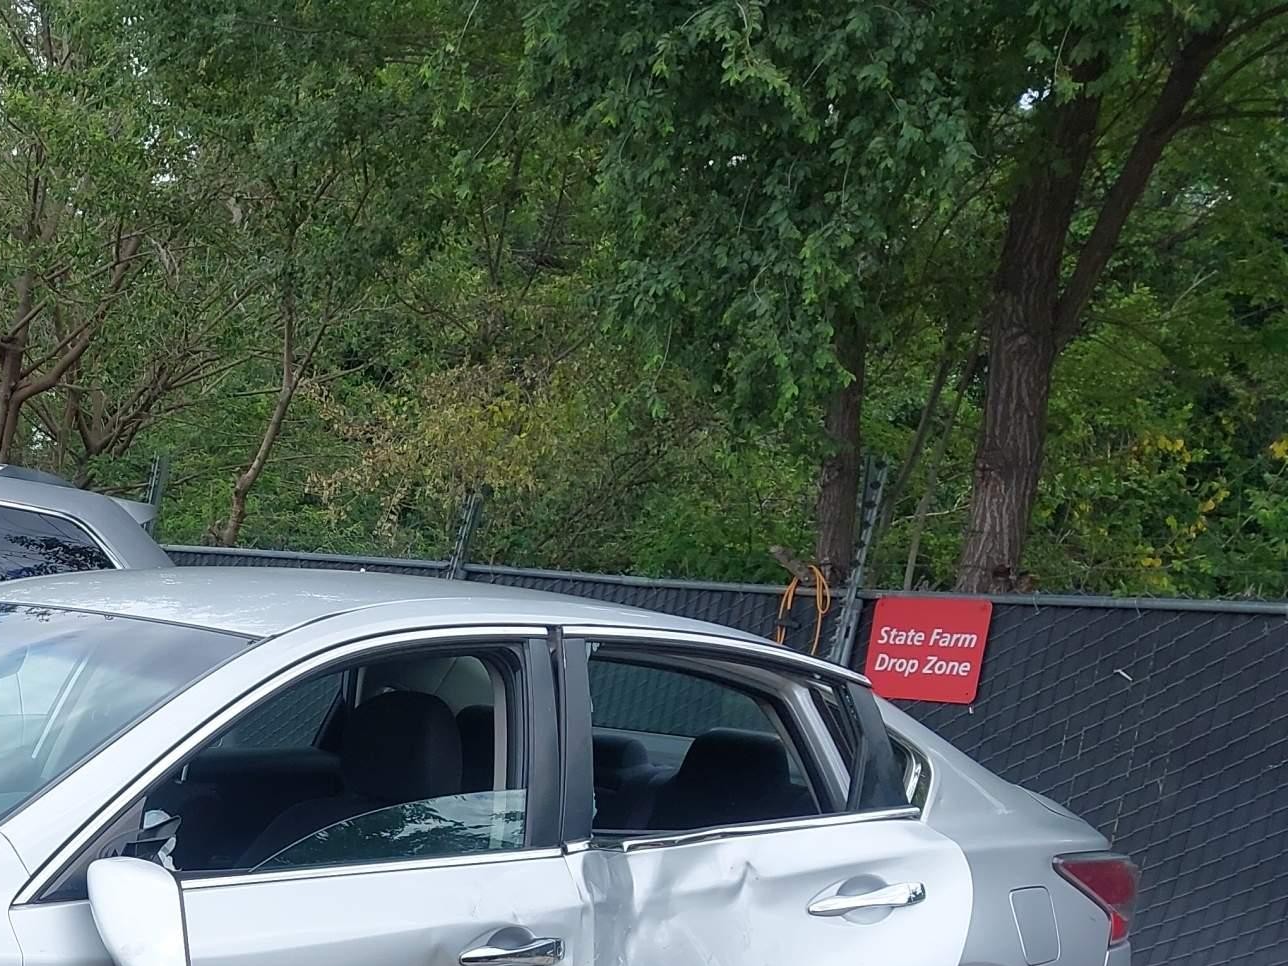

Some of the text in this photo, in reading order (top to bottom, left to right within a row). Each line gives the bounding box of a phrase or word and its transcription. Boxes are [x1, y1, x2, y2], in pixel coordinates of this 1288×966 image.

[877, 626, 978, 648] State Farm
[874, 653, 971, 677] Drop Zone
